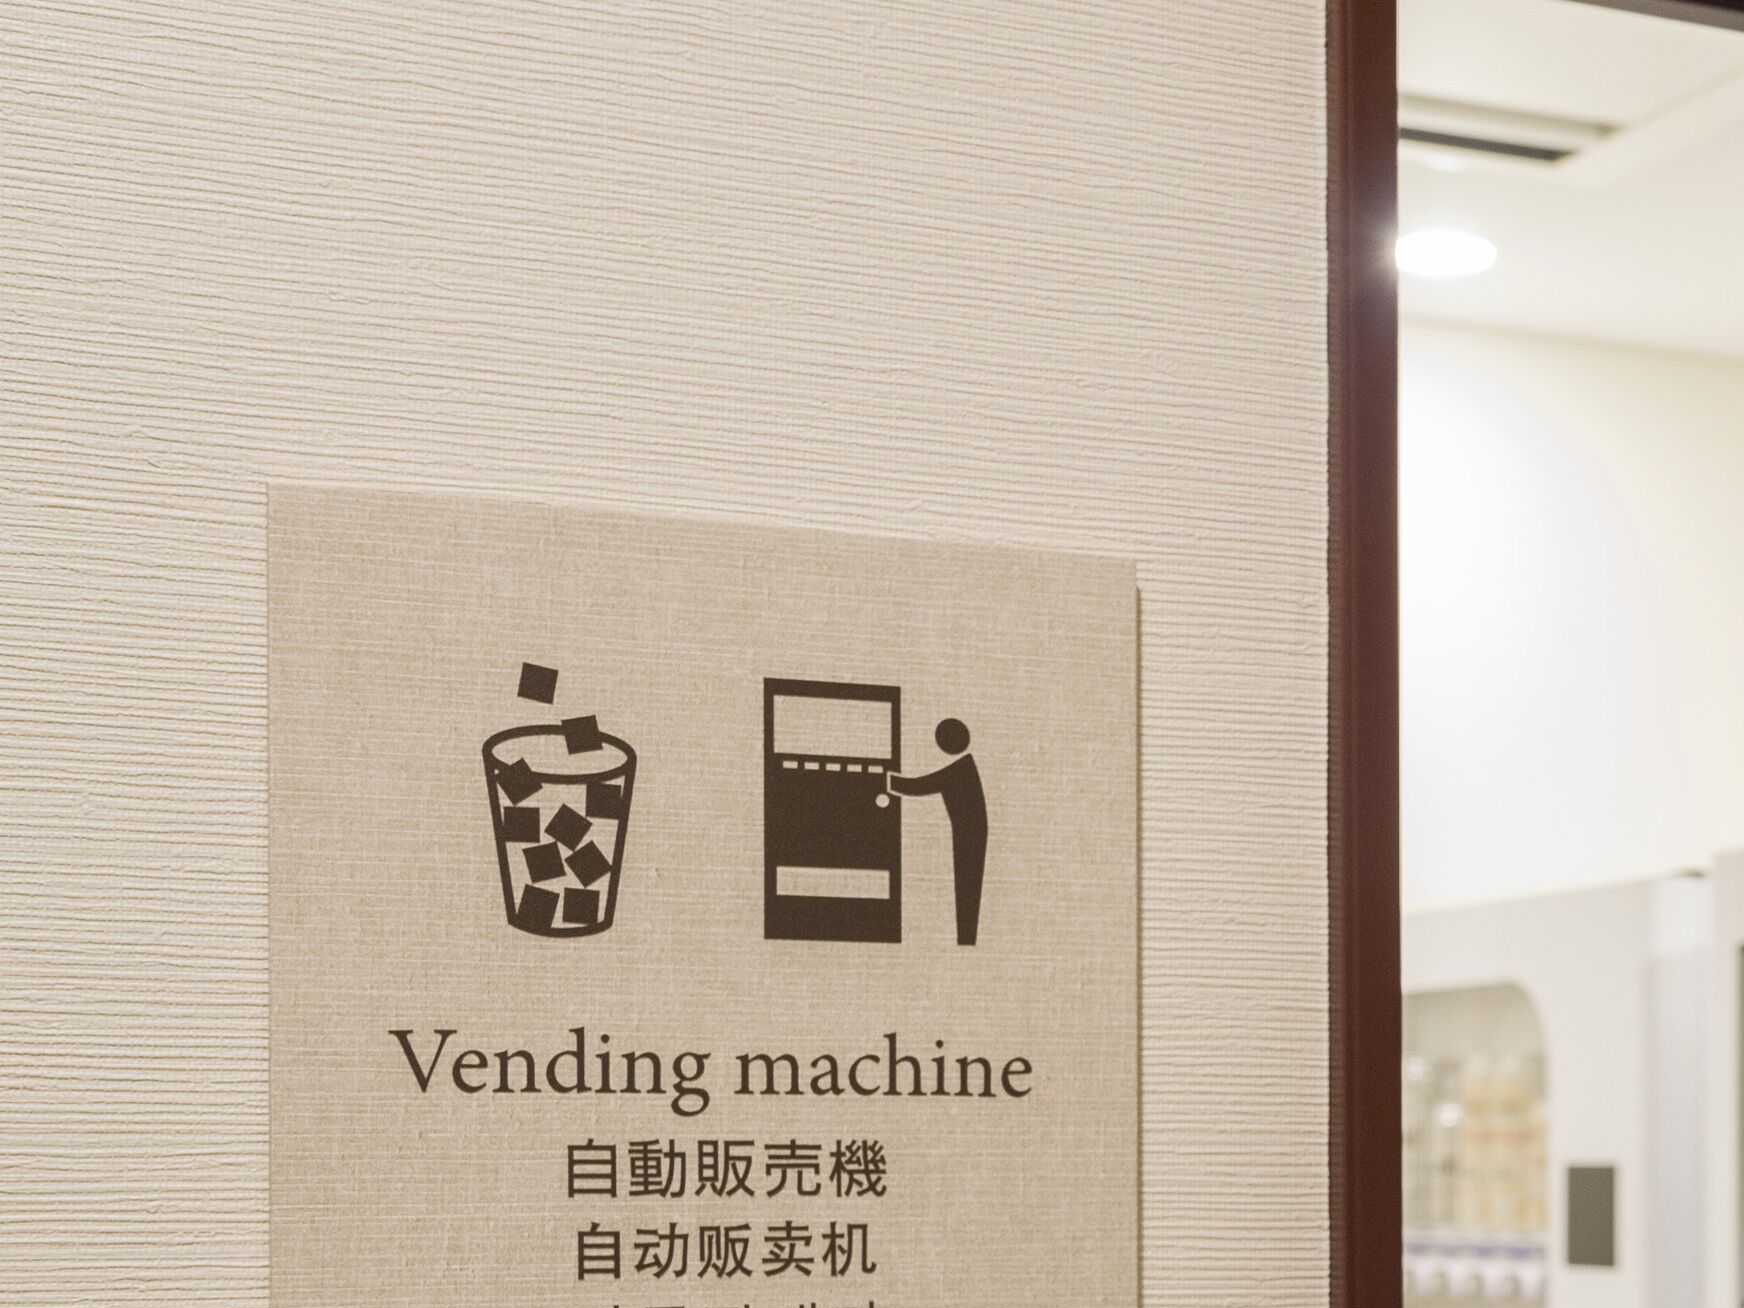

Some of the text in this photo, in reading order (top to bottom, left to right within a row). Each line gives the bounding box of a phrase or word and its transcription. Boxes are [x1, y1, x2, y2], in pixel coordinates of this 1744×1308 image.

[388, 1027, 1033, 1117] Vending machine
[566, 1138, 888, 1199] 自動販売機
[576, 1220, 878, 1281] 自动贩卖机
